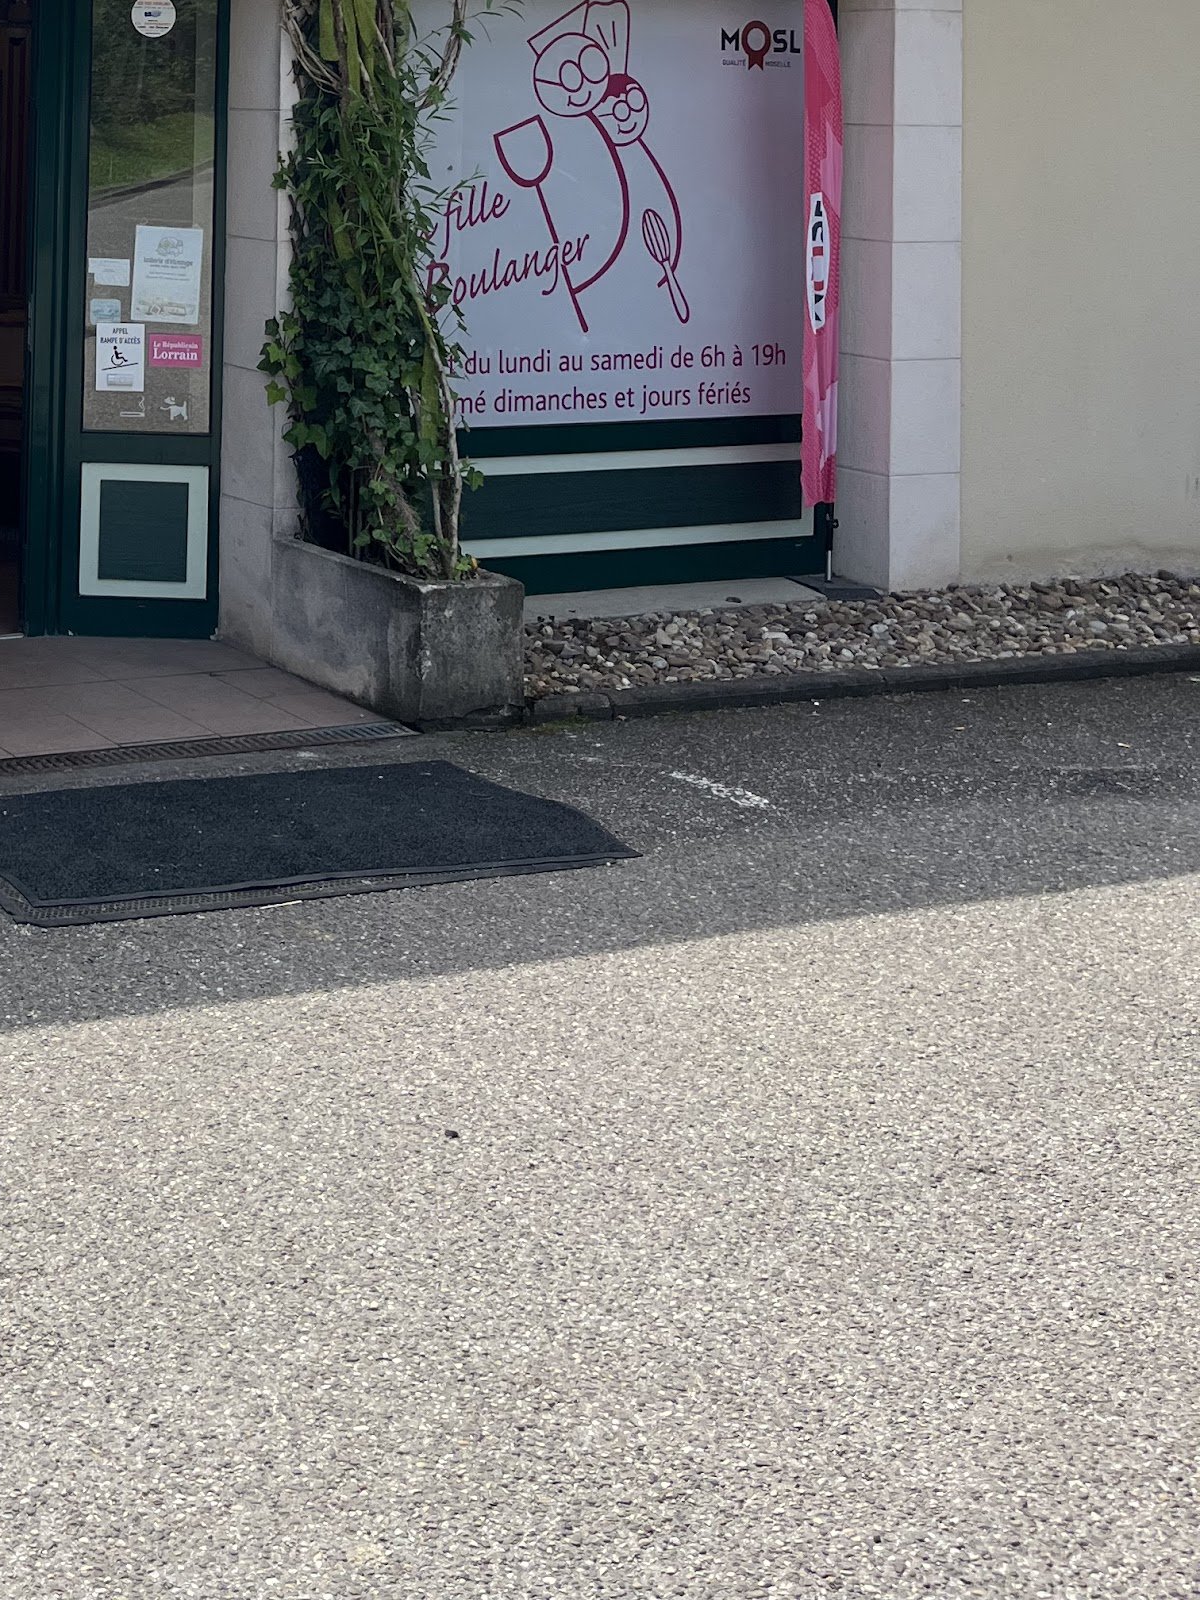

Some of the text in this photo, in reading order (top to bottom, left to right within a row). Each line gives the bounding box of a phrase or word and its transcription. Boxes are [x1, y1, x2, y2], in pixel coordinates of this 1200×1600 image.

[721, 21, 801, 54] MOSL
[440, 180, 511, 260] fille
[112, 327, 128, 335] APPEL
[152, 347, 198, 361] Lorrain
[464, 350, 491, 375] du
[499, 349, 551, 374] lundi
[558, 354, 583, 373] au
[590, 345, 663, 371] samedi
[670, 345, 694, 369] de
[701, 344, 725, 368] 6h
[732, 344, 743, 367] à
[751, 343, 786, 367] 19h
[494, 386, 607, 413] dimanches
[614, 387, 635, 408] et
[639, 384, 691, 415] jours
[697, 381, 751, 406] fériés
